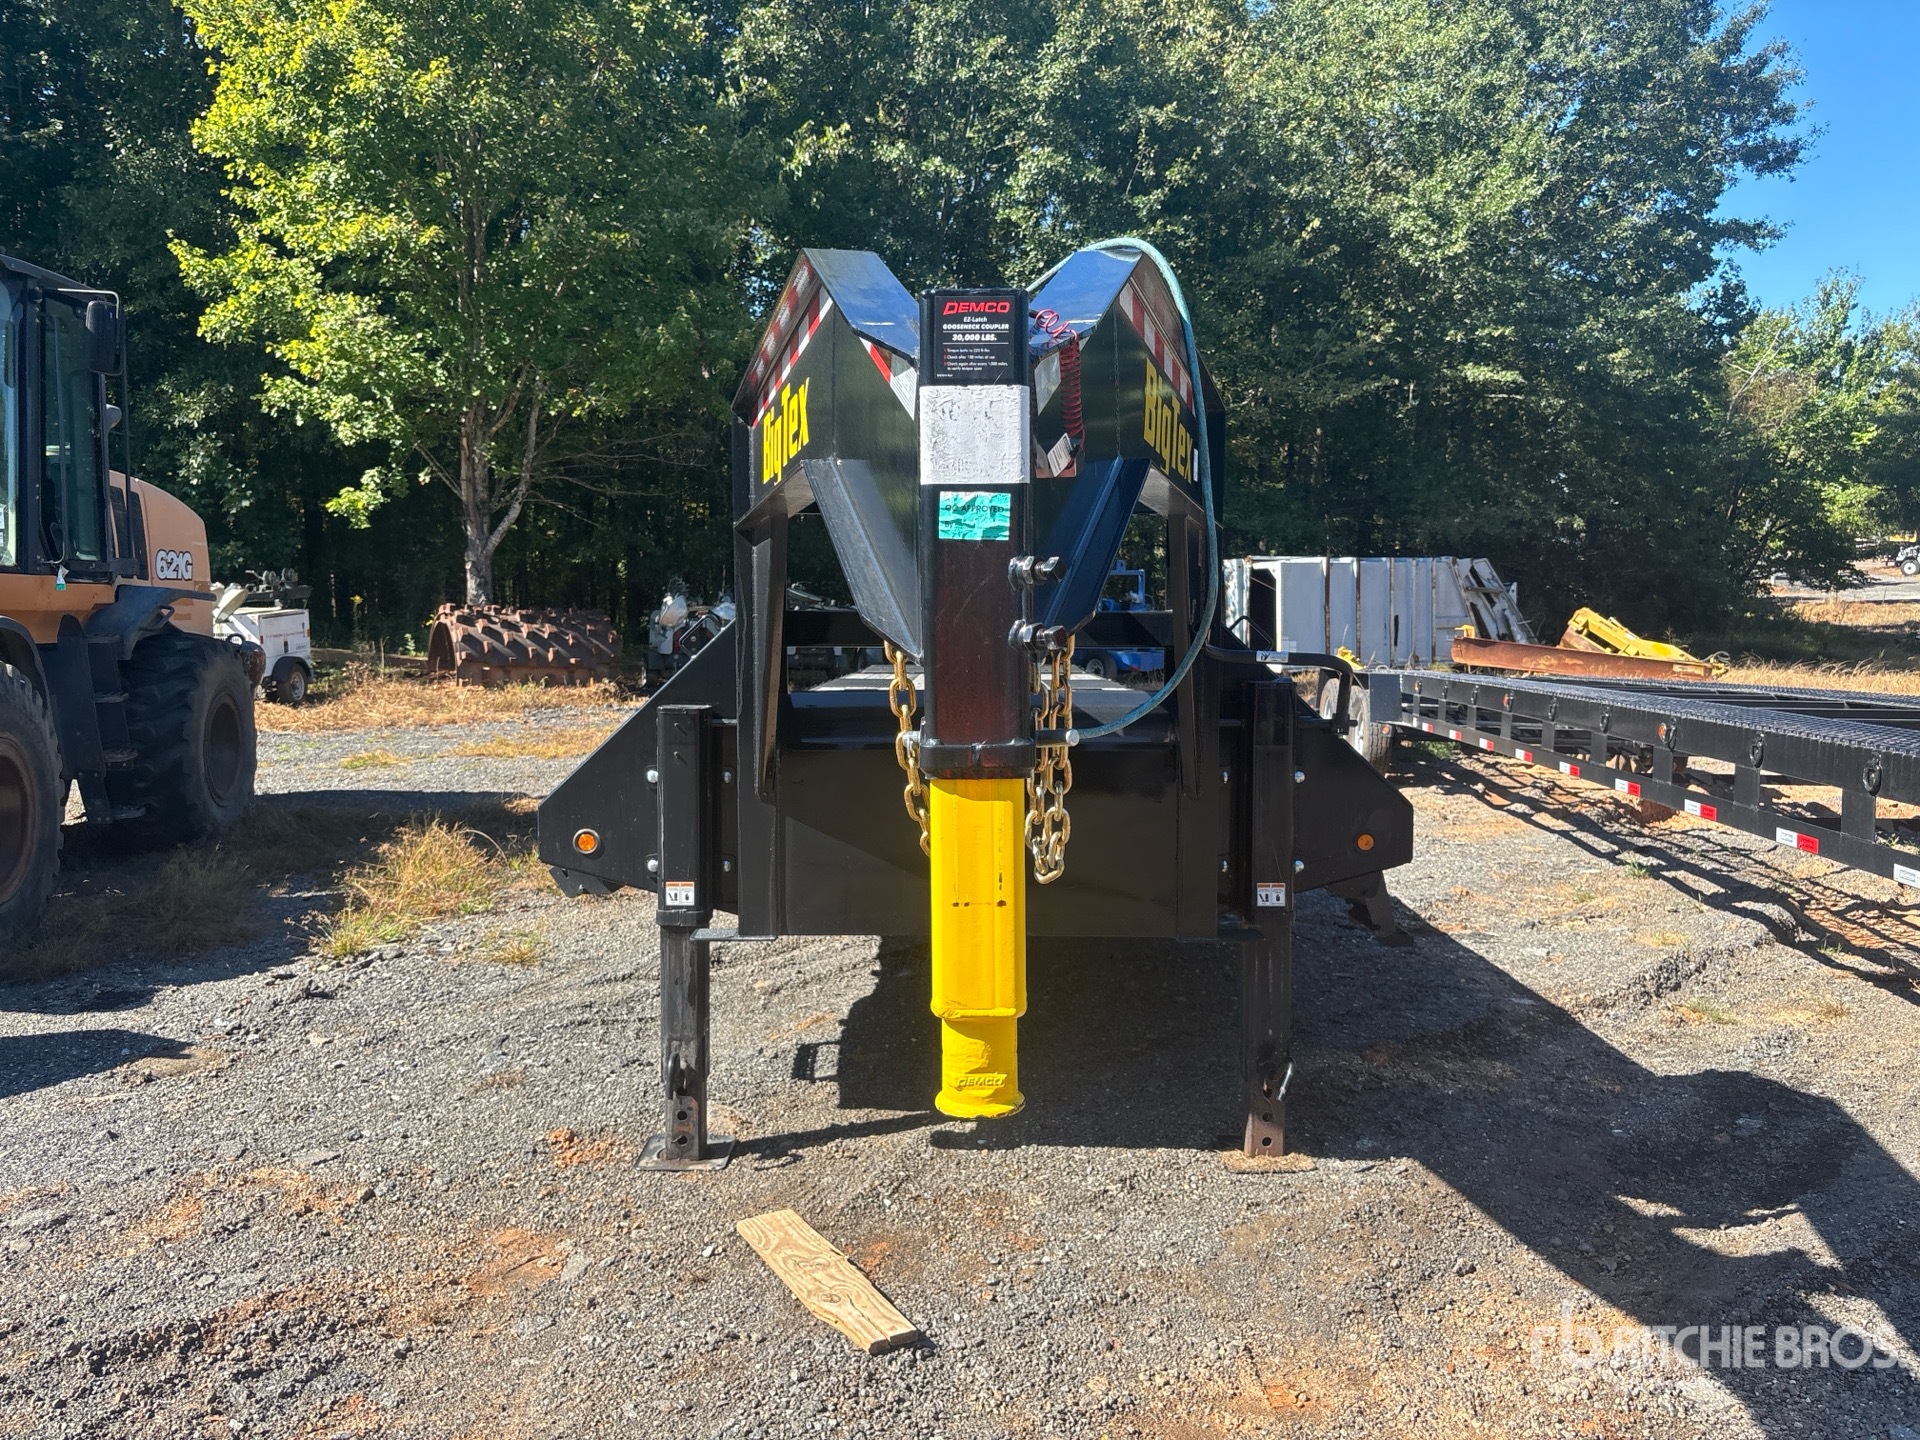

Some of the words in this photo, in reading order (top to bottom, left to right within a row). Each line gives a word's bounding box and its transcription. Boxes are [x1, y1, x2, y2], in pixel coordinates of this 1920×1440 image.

[943, 301, 1010, 315] DEMCO
[952, 333, 980, 342] 30,000
[961, 504, 1004, 512] APPROVED
[155, 548, 193, 581] 621G
